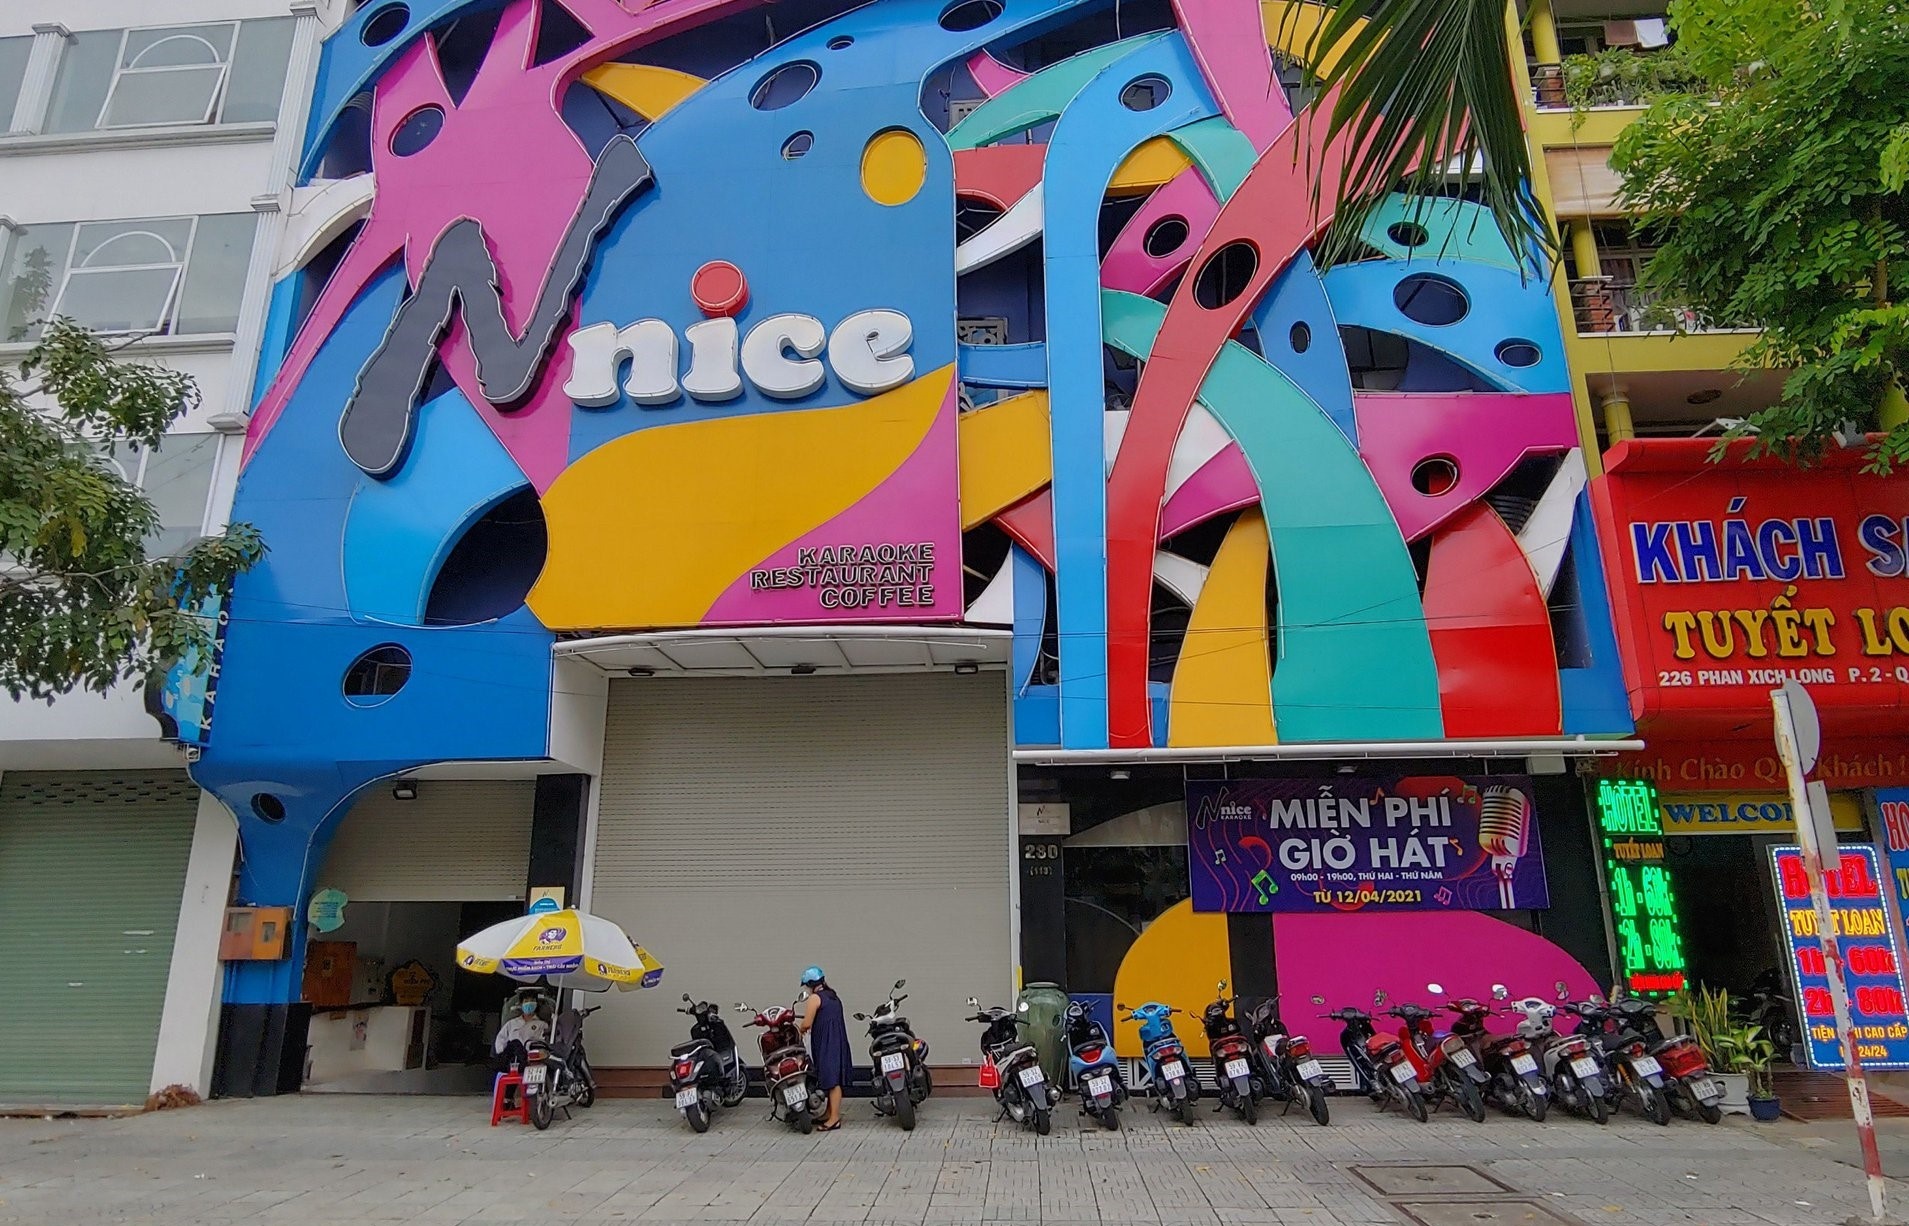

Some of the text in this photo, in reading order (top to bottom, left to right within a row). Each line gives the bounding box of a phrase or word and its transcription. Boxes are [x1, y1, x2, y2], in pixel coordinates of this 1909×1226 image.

[563, 259, 915, 408] nice
[1630, 496, 1909, 583] KHÁCH S
[799, 543, 935, 565] KARAOKE
[750, 564, 933, 589] RESTAURANT
[820, 585, 934, 608] COFFEE
[1663, 585, 1836, 659] TUYẾT
[1659, 670, 1693, 686] 226
[1698, 669, 1744, 686] PHAN
[1750, 669, 1786, 684] XICH
[1788, 668, 1835, 684] LONG
[1680, 757, 1745, 780] Chào
[1221, 801, 1252, 815] nice
[1270, 785, 1451, 829] MIỄN PHÍ
[1279, 829, 1450, 870] GIỜ HÁT
[1290, 873, 1319, 881] 09h00
[1327, 872, 1357, 881] 19h00,
[1358, 870, 1376, 880] THỨ
[1314, 888, 1422, 903] TỪ 12/04/2021
[1841, 909, 1886, 936] LOAN
[1796, 946, 1829, 975] 1h
[1803, 986, 1836, 1016] 2h
[1811, 1025, 1836, 1042] TIỆN
[1864, 1027, 1885, 1039] CAO
[1887, 1022, 1909, 1039] CẤP
[1858, 1045, 1888, 1058] 24/24
